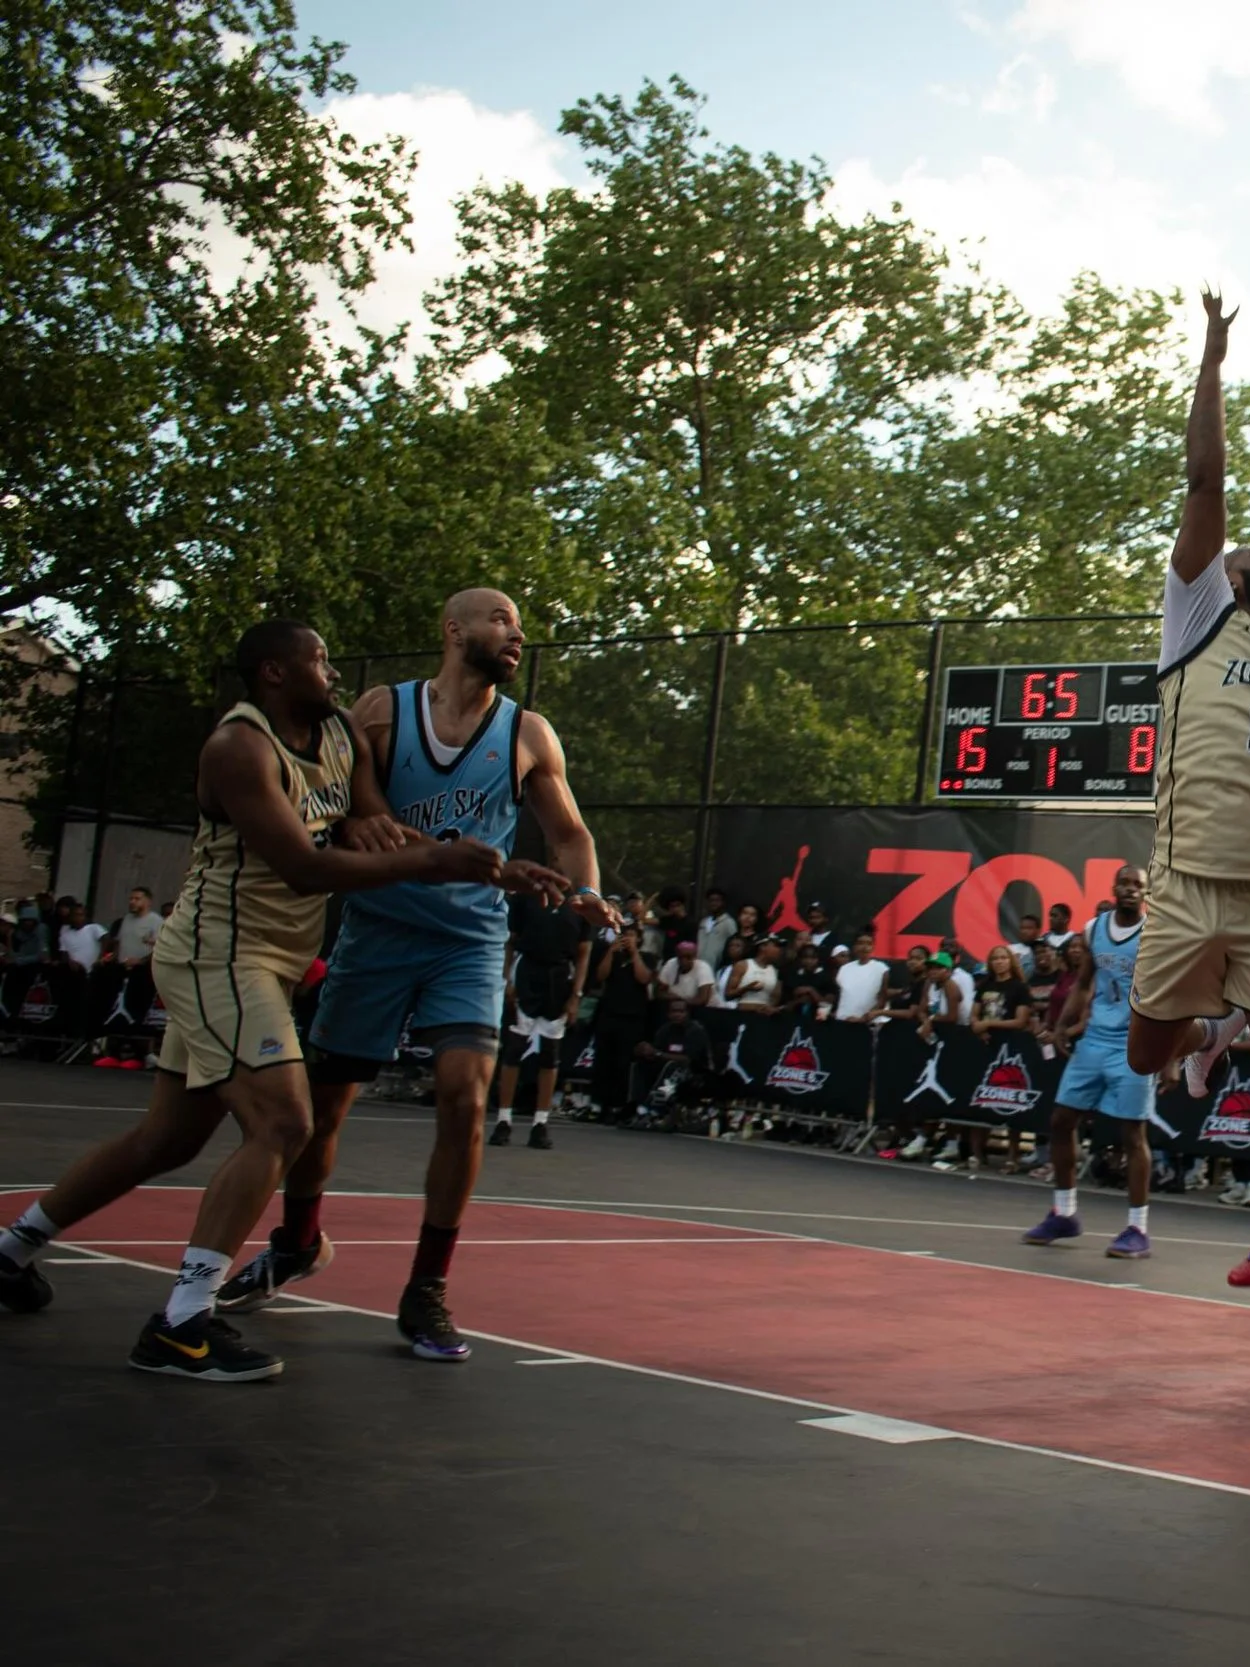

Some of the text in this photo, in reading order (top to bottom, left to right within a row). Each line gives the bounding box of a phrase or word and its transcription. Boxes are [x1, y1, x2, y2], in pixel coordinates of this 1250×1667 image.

[947, 706, 992, 725] HOME
[1105, 703, 1160, 723] GUEST
[1023, 727, 1071, 740] PERIOD
[1128, 725, 1157, 774] 8
[1046, 747, 1059, 788] 1
[964, 779, 1003, 790] BONUS
[1084, 779, 1126, 791] BONUS
[454, 788, 488, 822] SIX
[978, 1087, 1018, 1101] ZONE
[1208, 1118, 1250, 1132] ZONE
